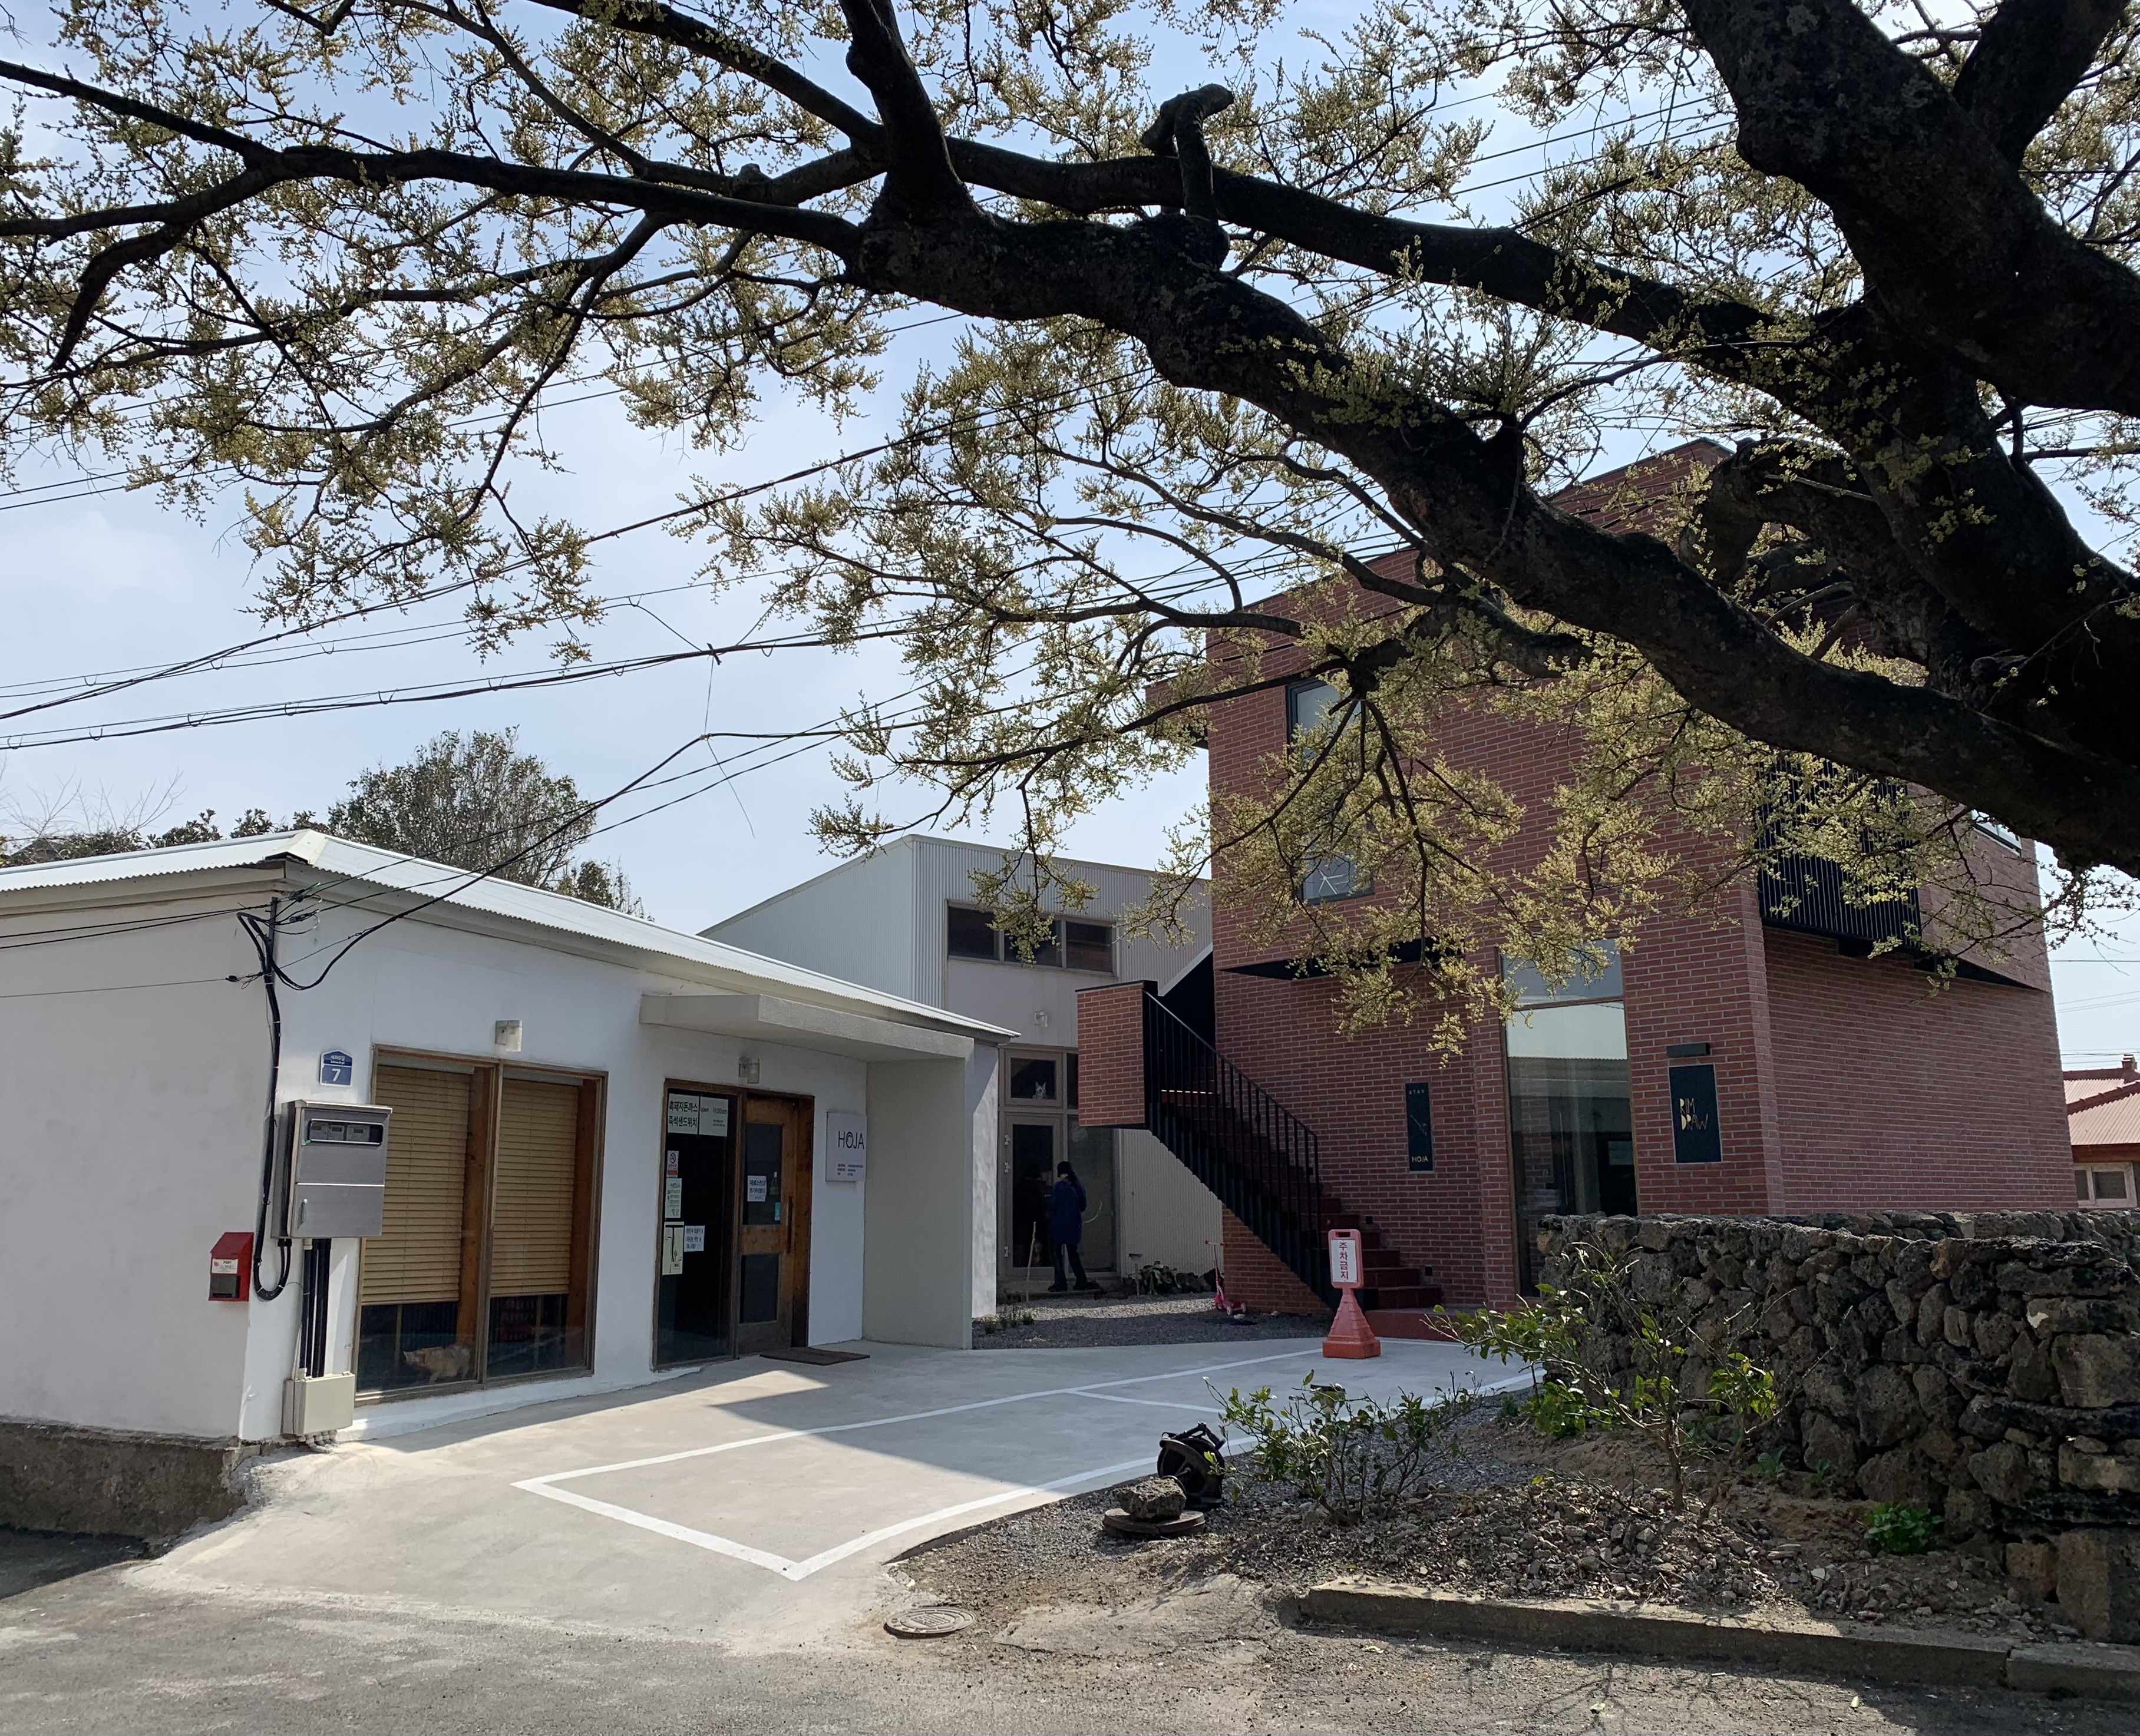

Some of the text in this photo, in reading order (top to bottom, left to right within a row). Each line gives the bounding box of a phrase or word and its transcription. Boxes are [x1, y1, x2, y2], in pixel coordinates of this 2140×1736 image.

[332, 1068, 341, 1082] 7
[669, 1100, 698, 1113] 흑돼지돈까스
[1681, 1112, 1709, 1130] DRAW
[838, 1130, 865, 1149] HOJA
[1339, 1242, 1349, 1280] 주차금지
